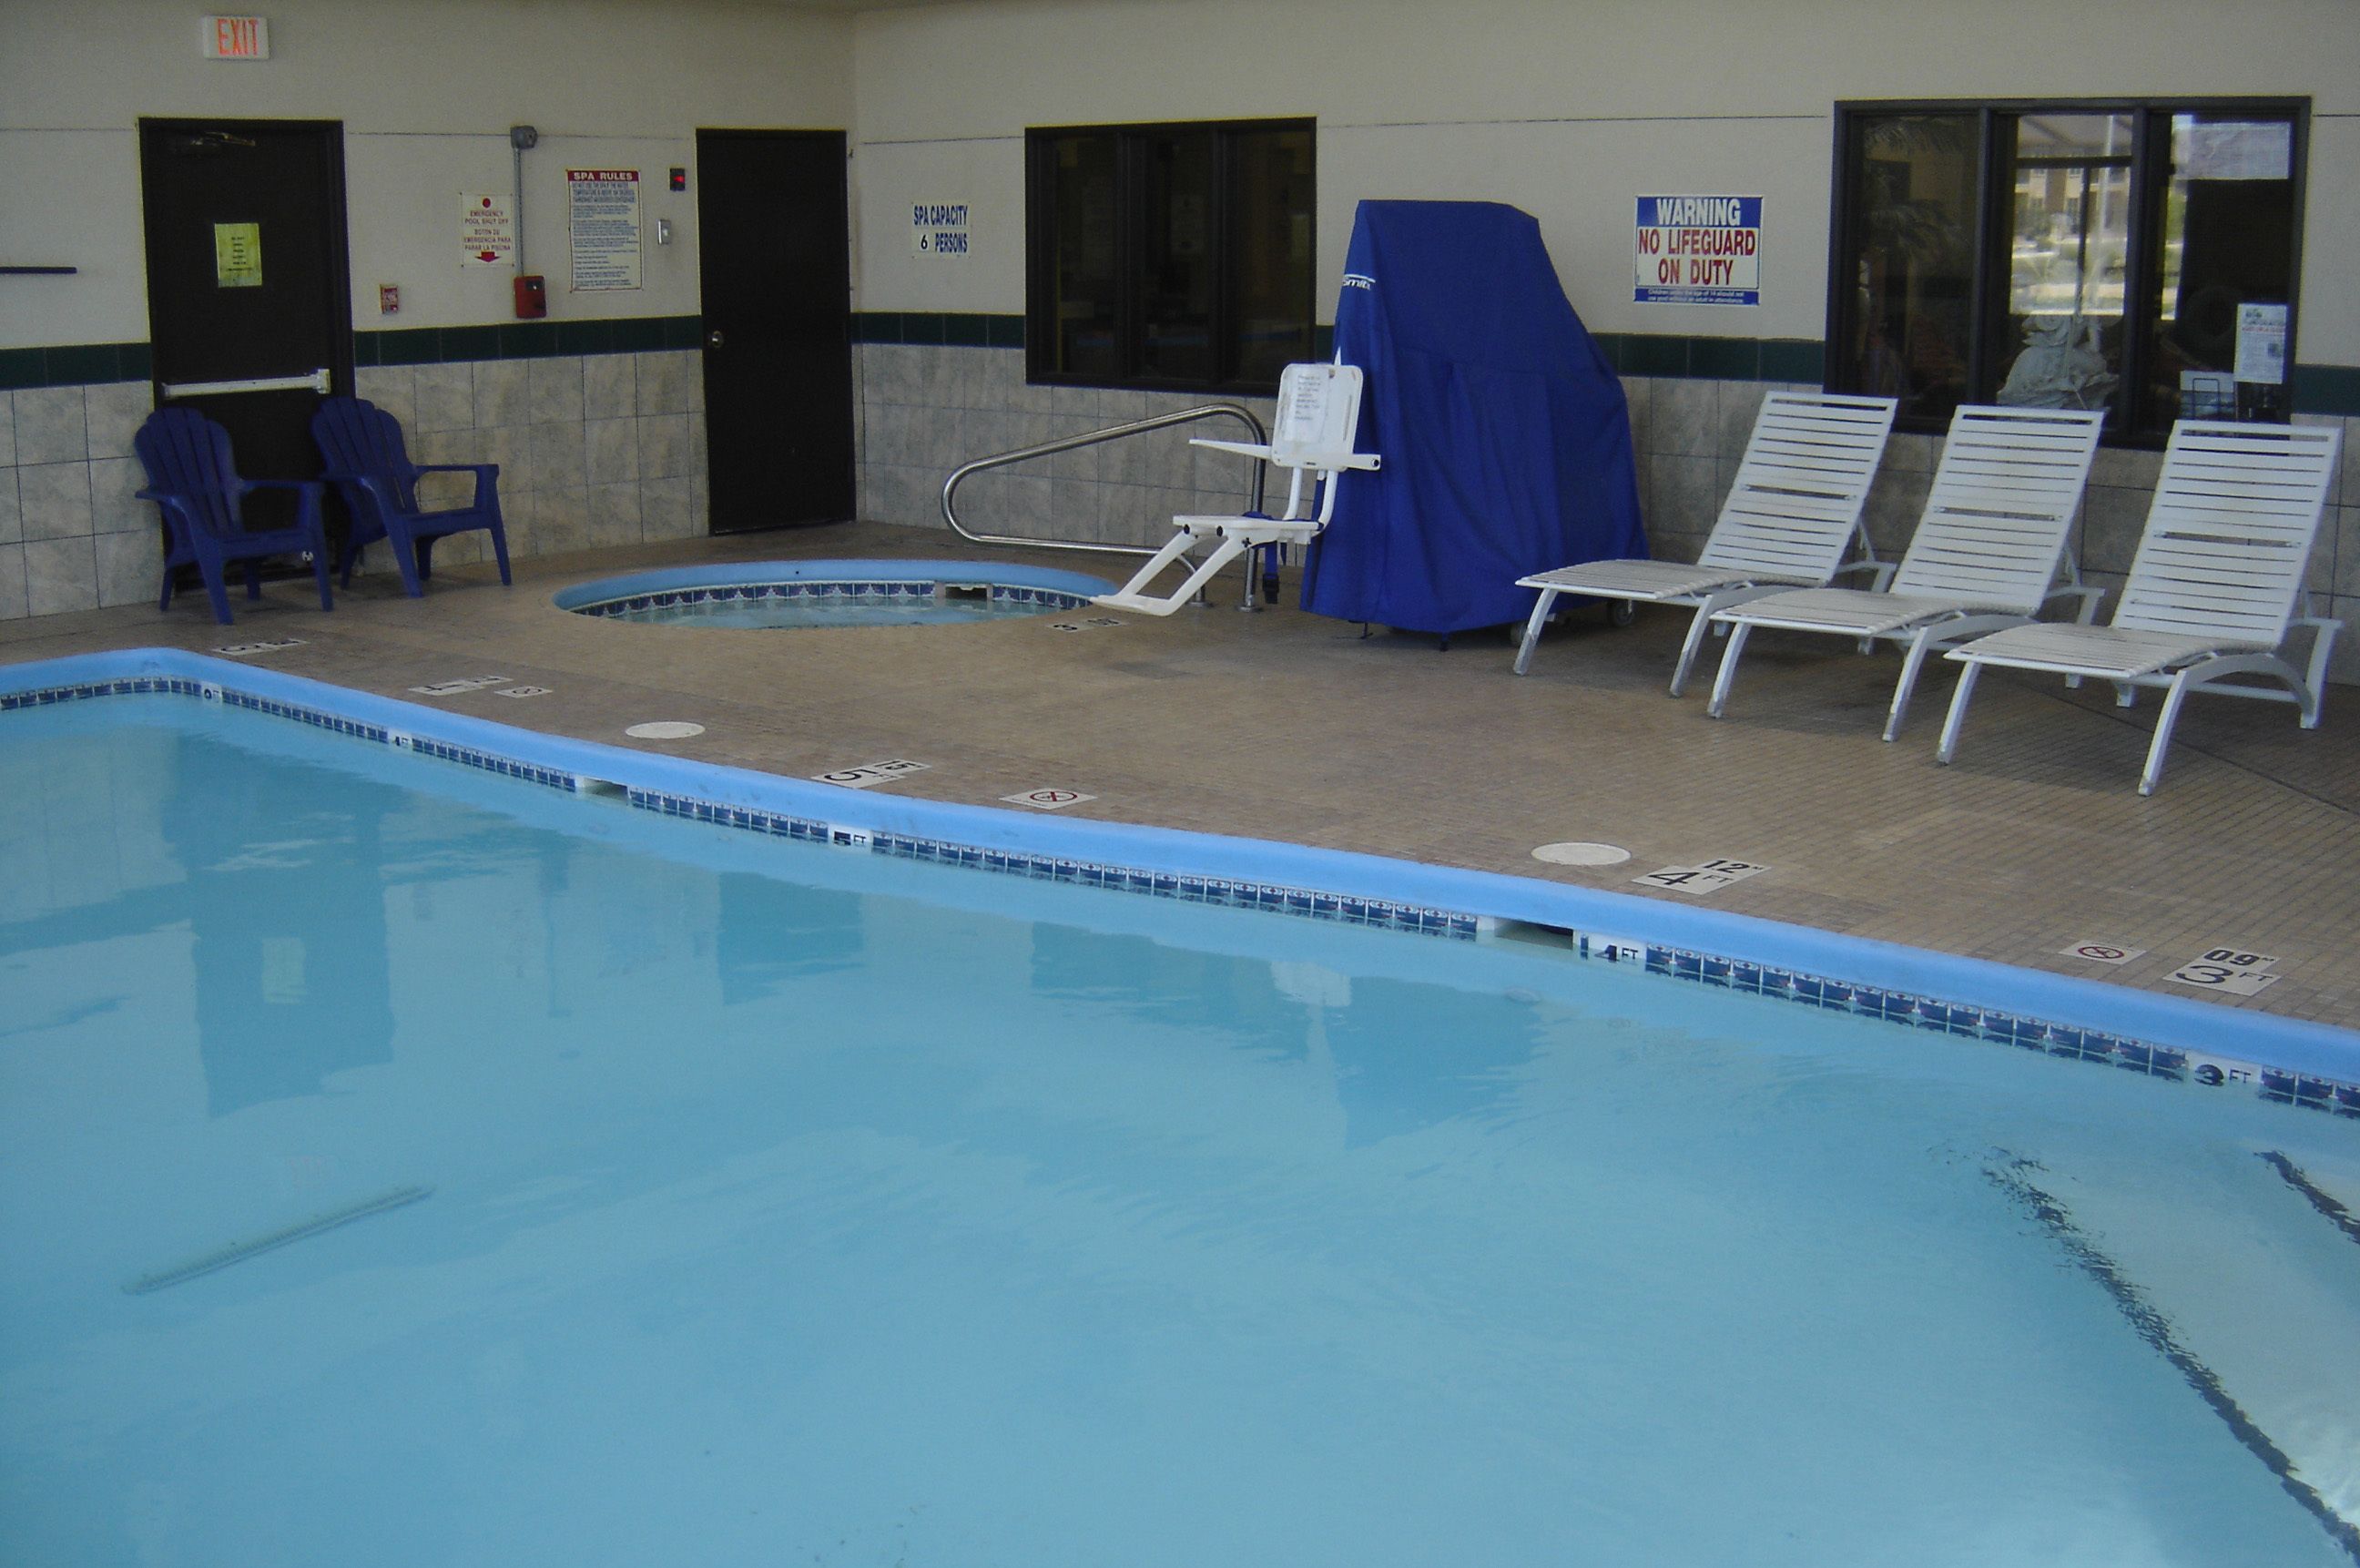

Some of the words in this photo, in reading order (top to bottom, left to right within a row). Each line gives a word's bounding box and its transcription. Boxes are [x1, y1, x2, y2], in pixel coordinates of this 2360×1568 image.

[218, 17, 259, 56] EXIT
[574, 171, 595, 181] SPA
[599, 171, 634, 181] RULES
[914, 205, 930, 226] SPA
[931, 205, 968, 226] CAPACITY
[1656, 198, 1742, 227] WARNING
[921, 234, 928, 249] 6
[935, 232, 968, 253] PERSONS
[1639, 229, 1660, 255] NO
[1668, 229, 1755, 256] LIFEGUARD
[1658, 258, 1680, 284] ON
[1690, 259, 1734, 285] DUTY
[1647, 871, 1701, 885] 4
[1703, 873, 1734, 883] FT
[1622, 947, 1639, 960] FT
[2175, 965, 2234, 983] 3
[2239, 972, 2274, 982] FT
[2229, 1069, 2252, 1084] FT
